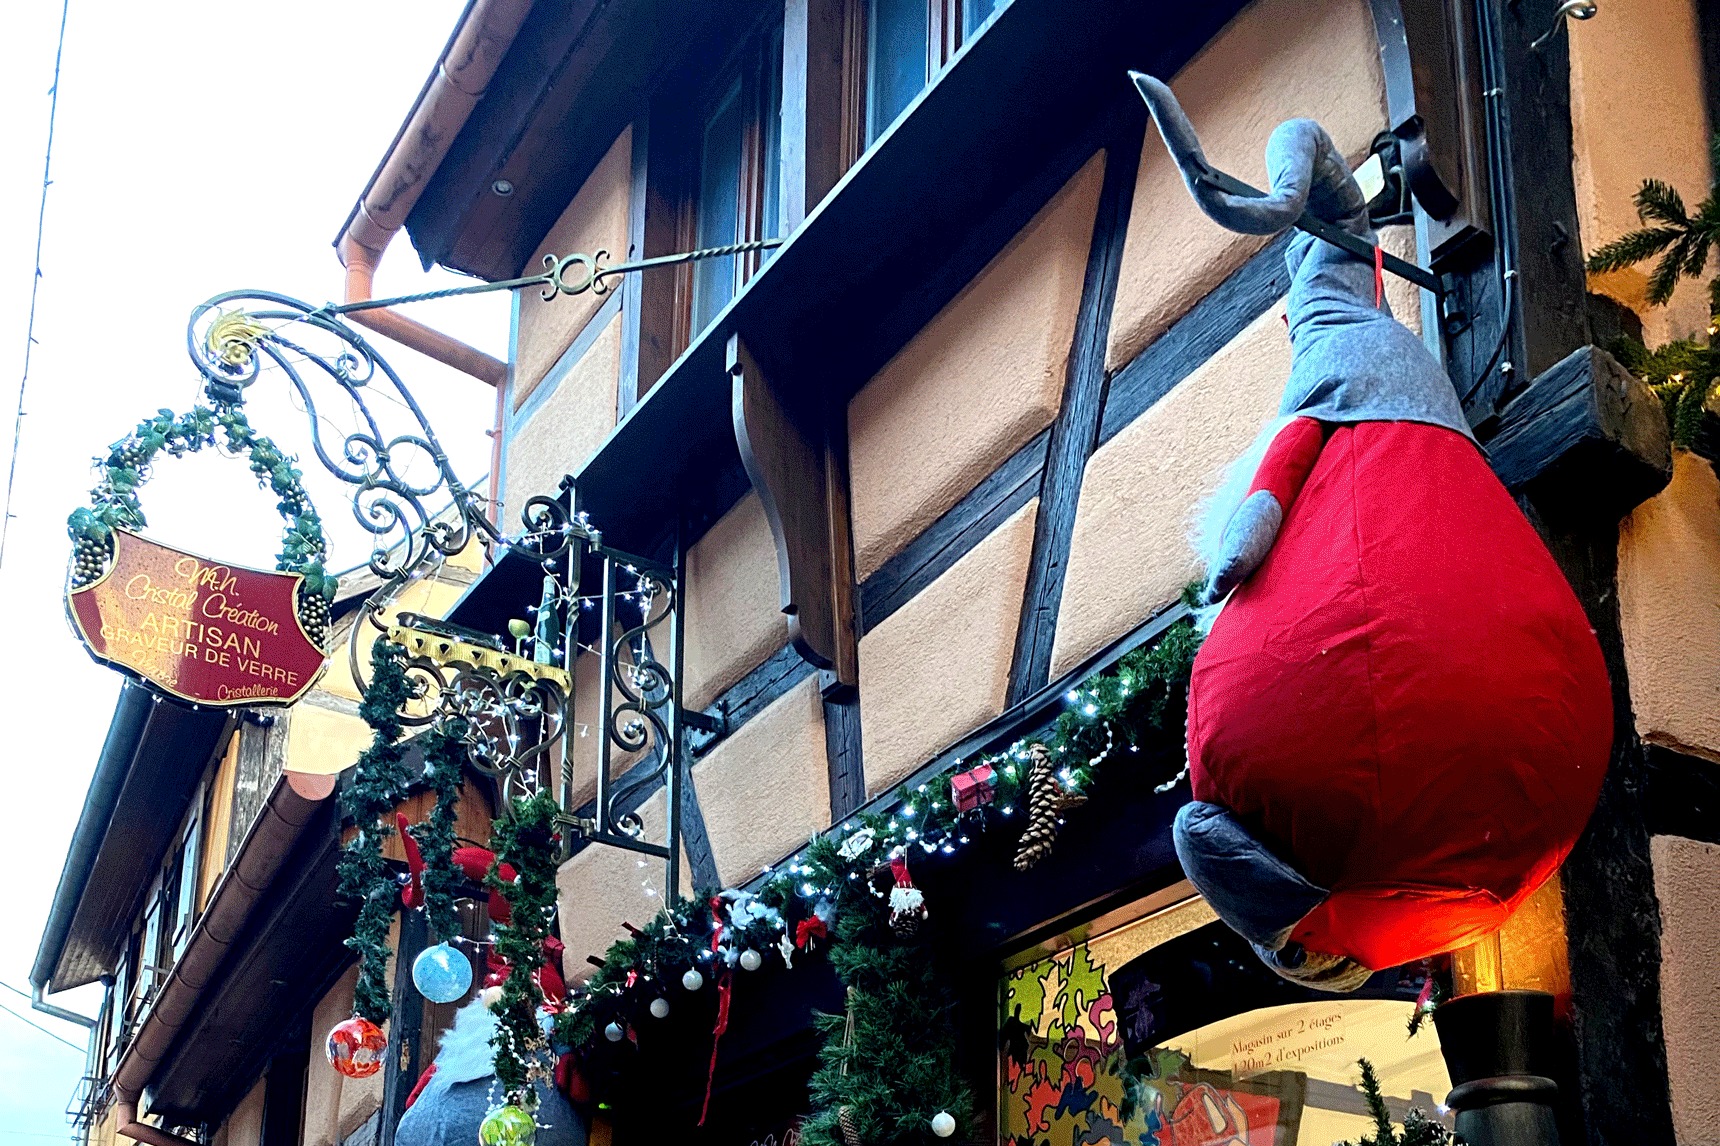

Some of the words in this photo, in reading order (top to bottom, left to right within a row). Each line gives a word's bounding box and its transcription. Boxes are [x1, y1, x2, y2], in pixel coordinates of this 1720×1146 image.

[125, 574, 198, 610] Cristal
[203, 592, 279, 636] Création
[100, 624, 197, 658] GRAVEUR
[205, 650, 231, 667] DE
[238, 657, 298, 686] VERRE
[141, 612, 260, 658] ARTISAN
[217, 684, 279, 700] Cristallerie
[1232, 1035, 1273, 1055] Magasin
[1276, 1028, 1293, 1041] sur
[1297, 1020, 1306, 1034] 2
[1309, 1012, 1342, 1030] étages
[1233, 1053, 1273, 1075] 120m2
[1276, 1035, 1345, 1062] d'expositions
